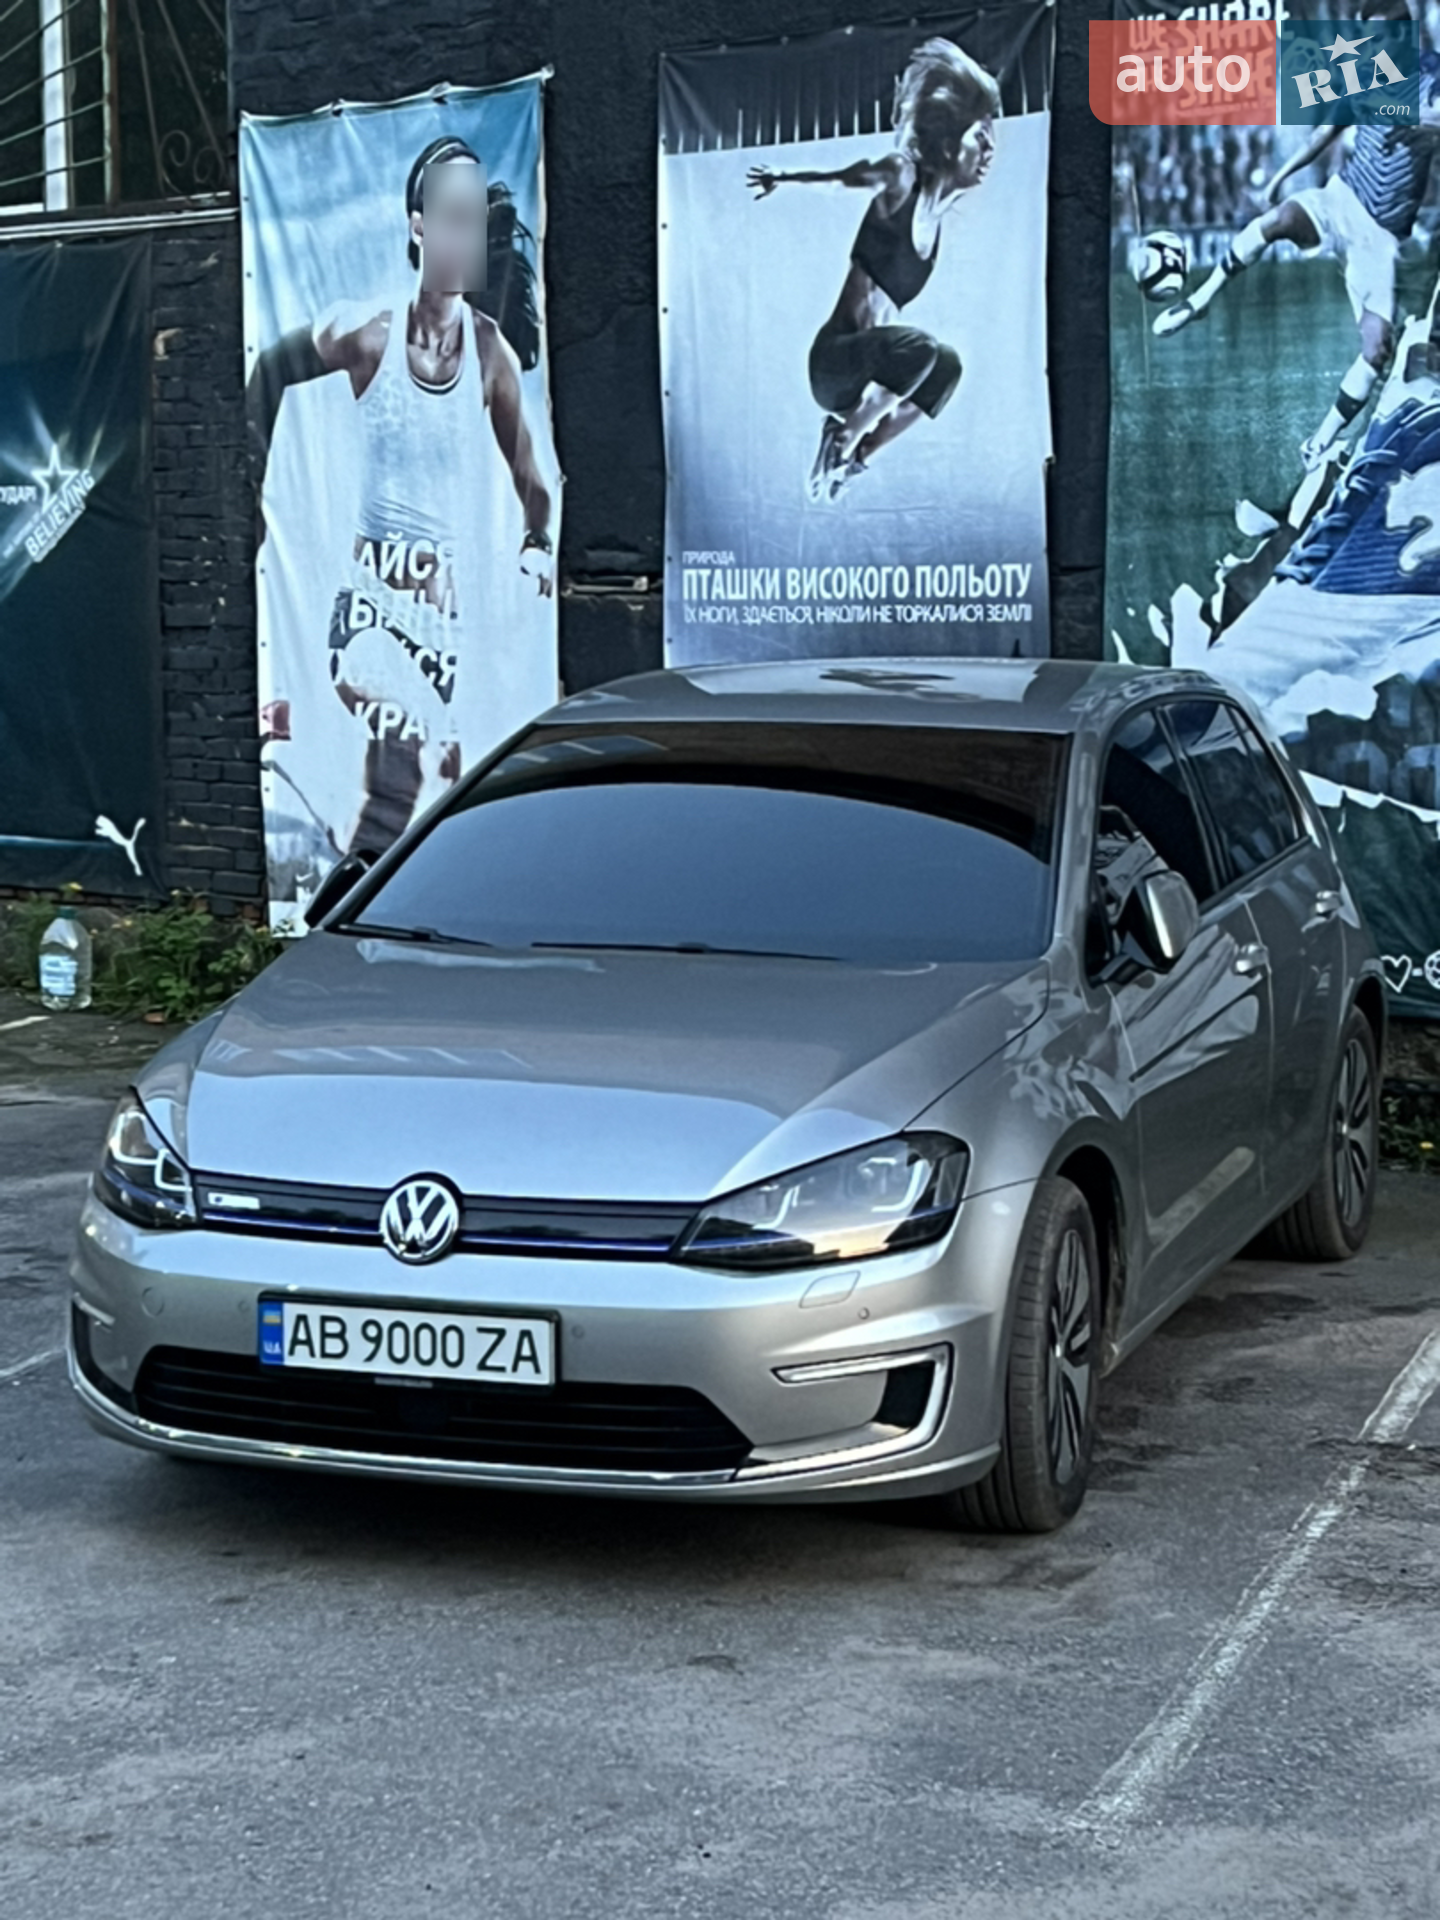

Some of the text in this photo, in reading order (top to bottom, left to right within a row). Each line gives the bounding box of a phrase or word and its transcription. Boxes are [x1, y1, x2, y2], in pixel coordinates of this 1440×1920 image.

[25, 469, 95, 558] BELIEVING
[683, 551, 735, 566] ПРИРОДА
[683, 563, 1032, 600] ПТАШКИ ВИСОКОГО ПОЛЬОТУ
[816, 604, 871, 623] НІКОЛИ
[873, 604, 893, 623] НЕ
[895, 603, 984, 623] ТОРКАЛИСЯ
[263, 1341, 282, 1355] UA
[288, 1313, 542, 1375] AB 9000 ZA
